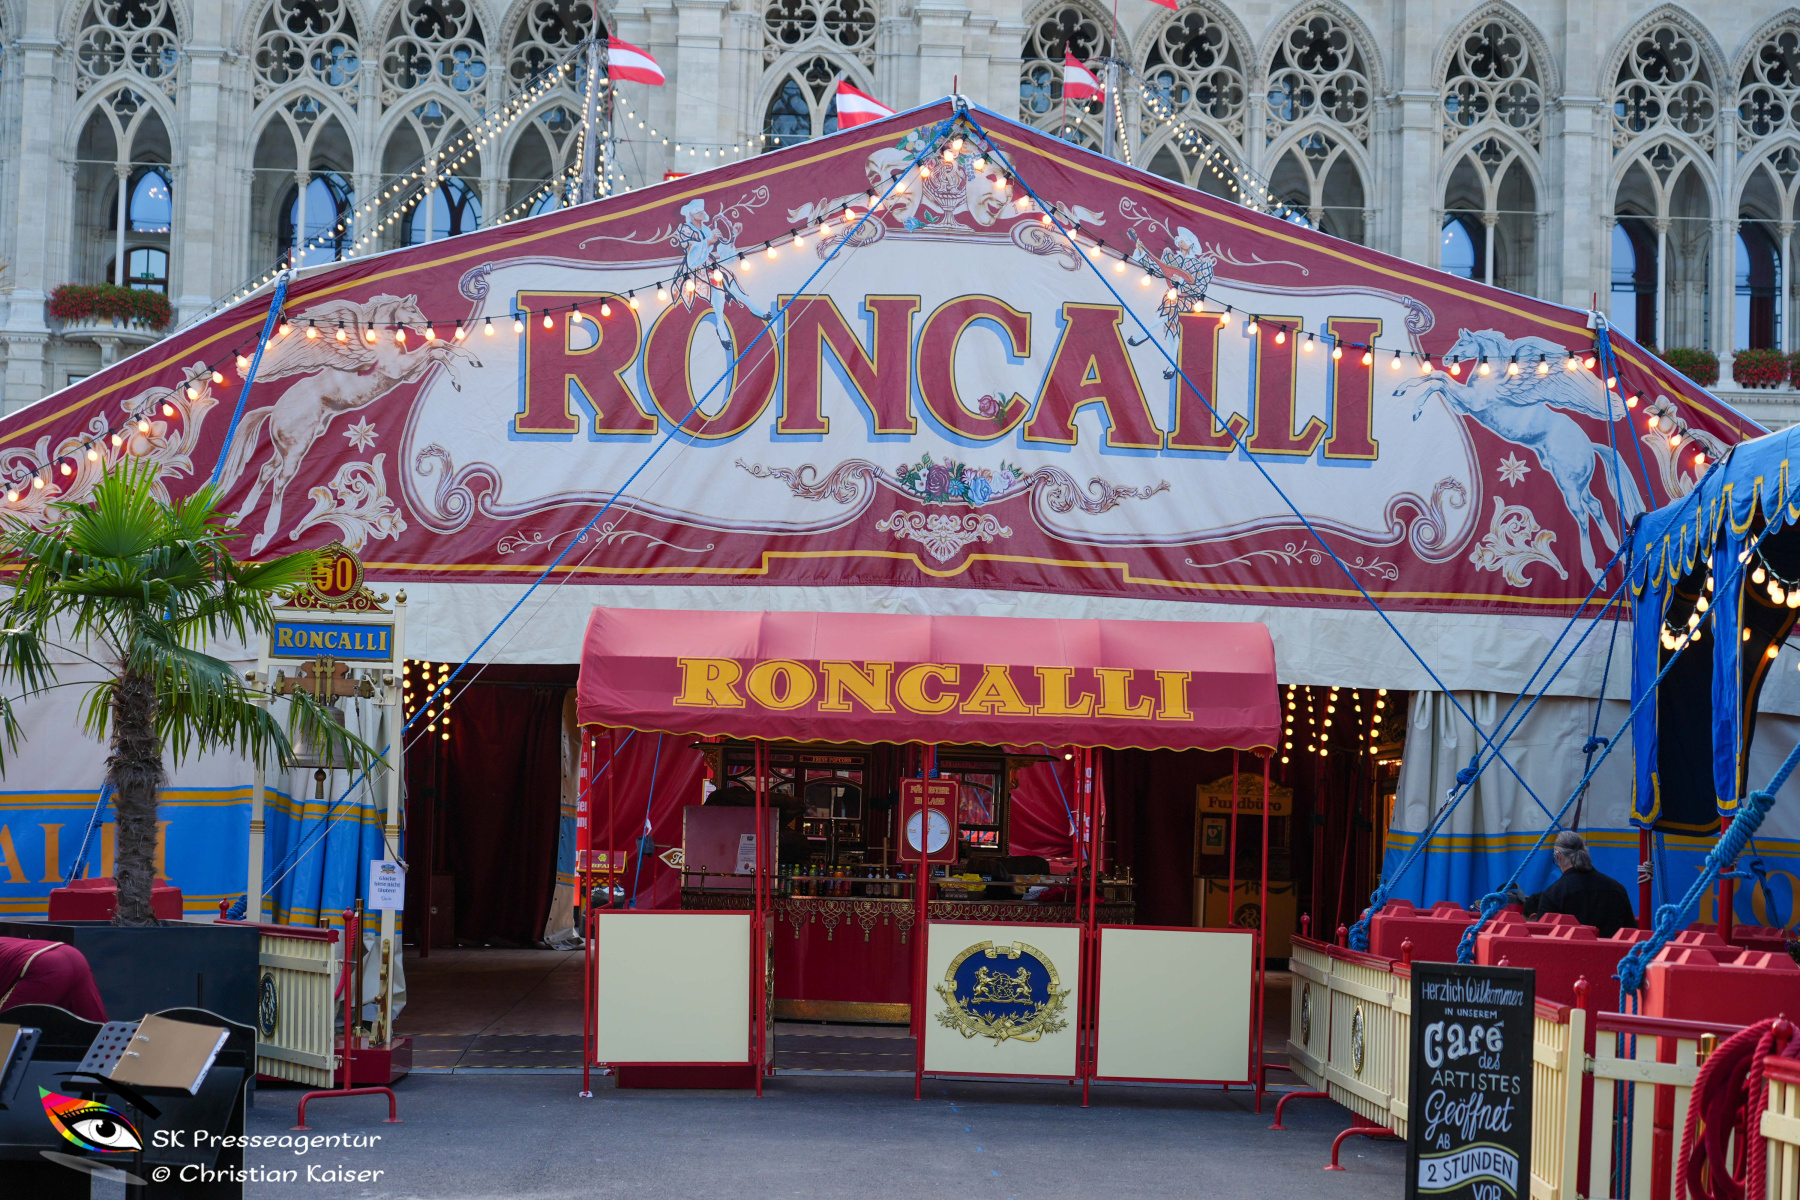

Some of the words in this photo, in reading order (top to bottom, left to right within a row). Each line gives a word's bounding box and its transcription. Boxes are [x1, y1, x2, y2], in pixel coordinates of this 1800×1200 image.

[512, 293, 1384, 461] RONCALLI
[316, 557, 352, 592] 50
[277, 627, 388, 651] RONCALLI
[672, 656, 1195, 722] RONCALLI
[910, 785, 950, 794] NÄSTER
[914, 797, 945, 805] EILASS
[1421, 978, 1465, 1003] Herzlich
[1444, 1007, 1454, 1016] IN
[1456, 1008, 1498, 1019] UNSEREM
[1424, 1020, 1505, 1069] Café
[1478, 1051, 1501, 1071] des
[1430, 1070, 1521, 1095] ARTISTES
[1424, 1088, 1515, 1142] Geöffnet
[1436, 1133, 1451, 1150] AB
[1427, 1163, 1438, 1183] 2
[1443, 1151, 1513, 1182] STUNDEN
[1472, 1183, 1502, 1200] VOR
